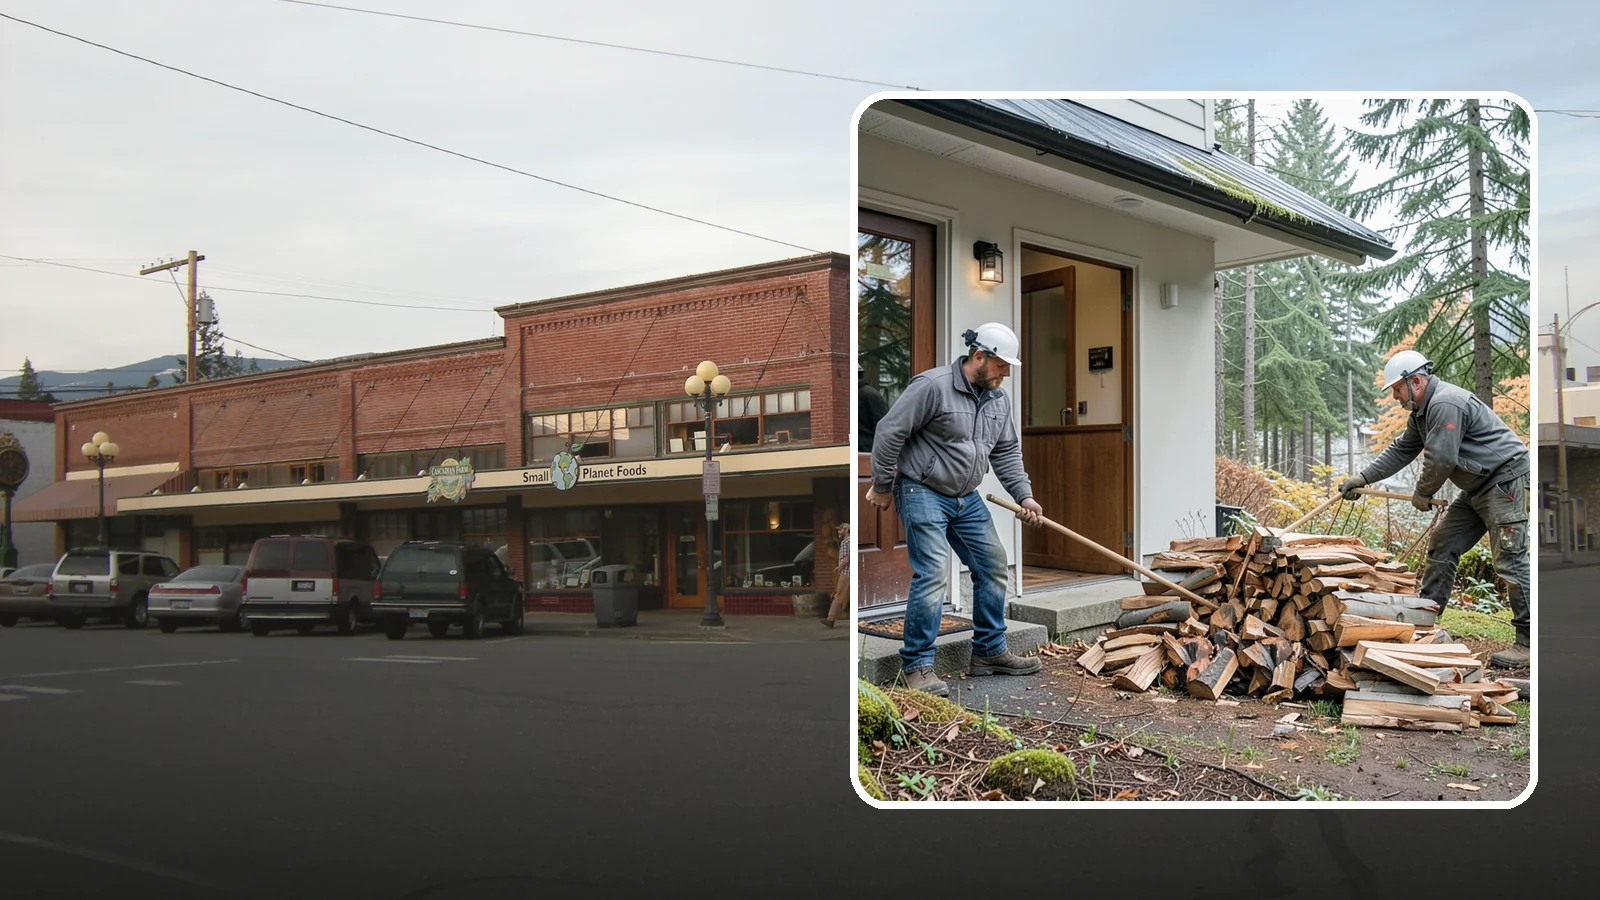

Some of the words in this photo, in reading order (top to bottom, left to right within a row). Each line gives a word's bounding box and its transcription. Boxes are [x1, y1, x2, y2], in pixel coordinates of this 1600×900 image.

[523, 471, 549, 483] Small
[583, 468, 615, 479] Planet
[617, 464, 647, 477] Foods
